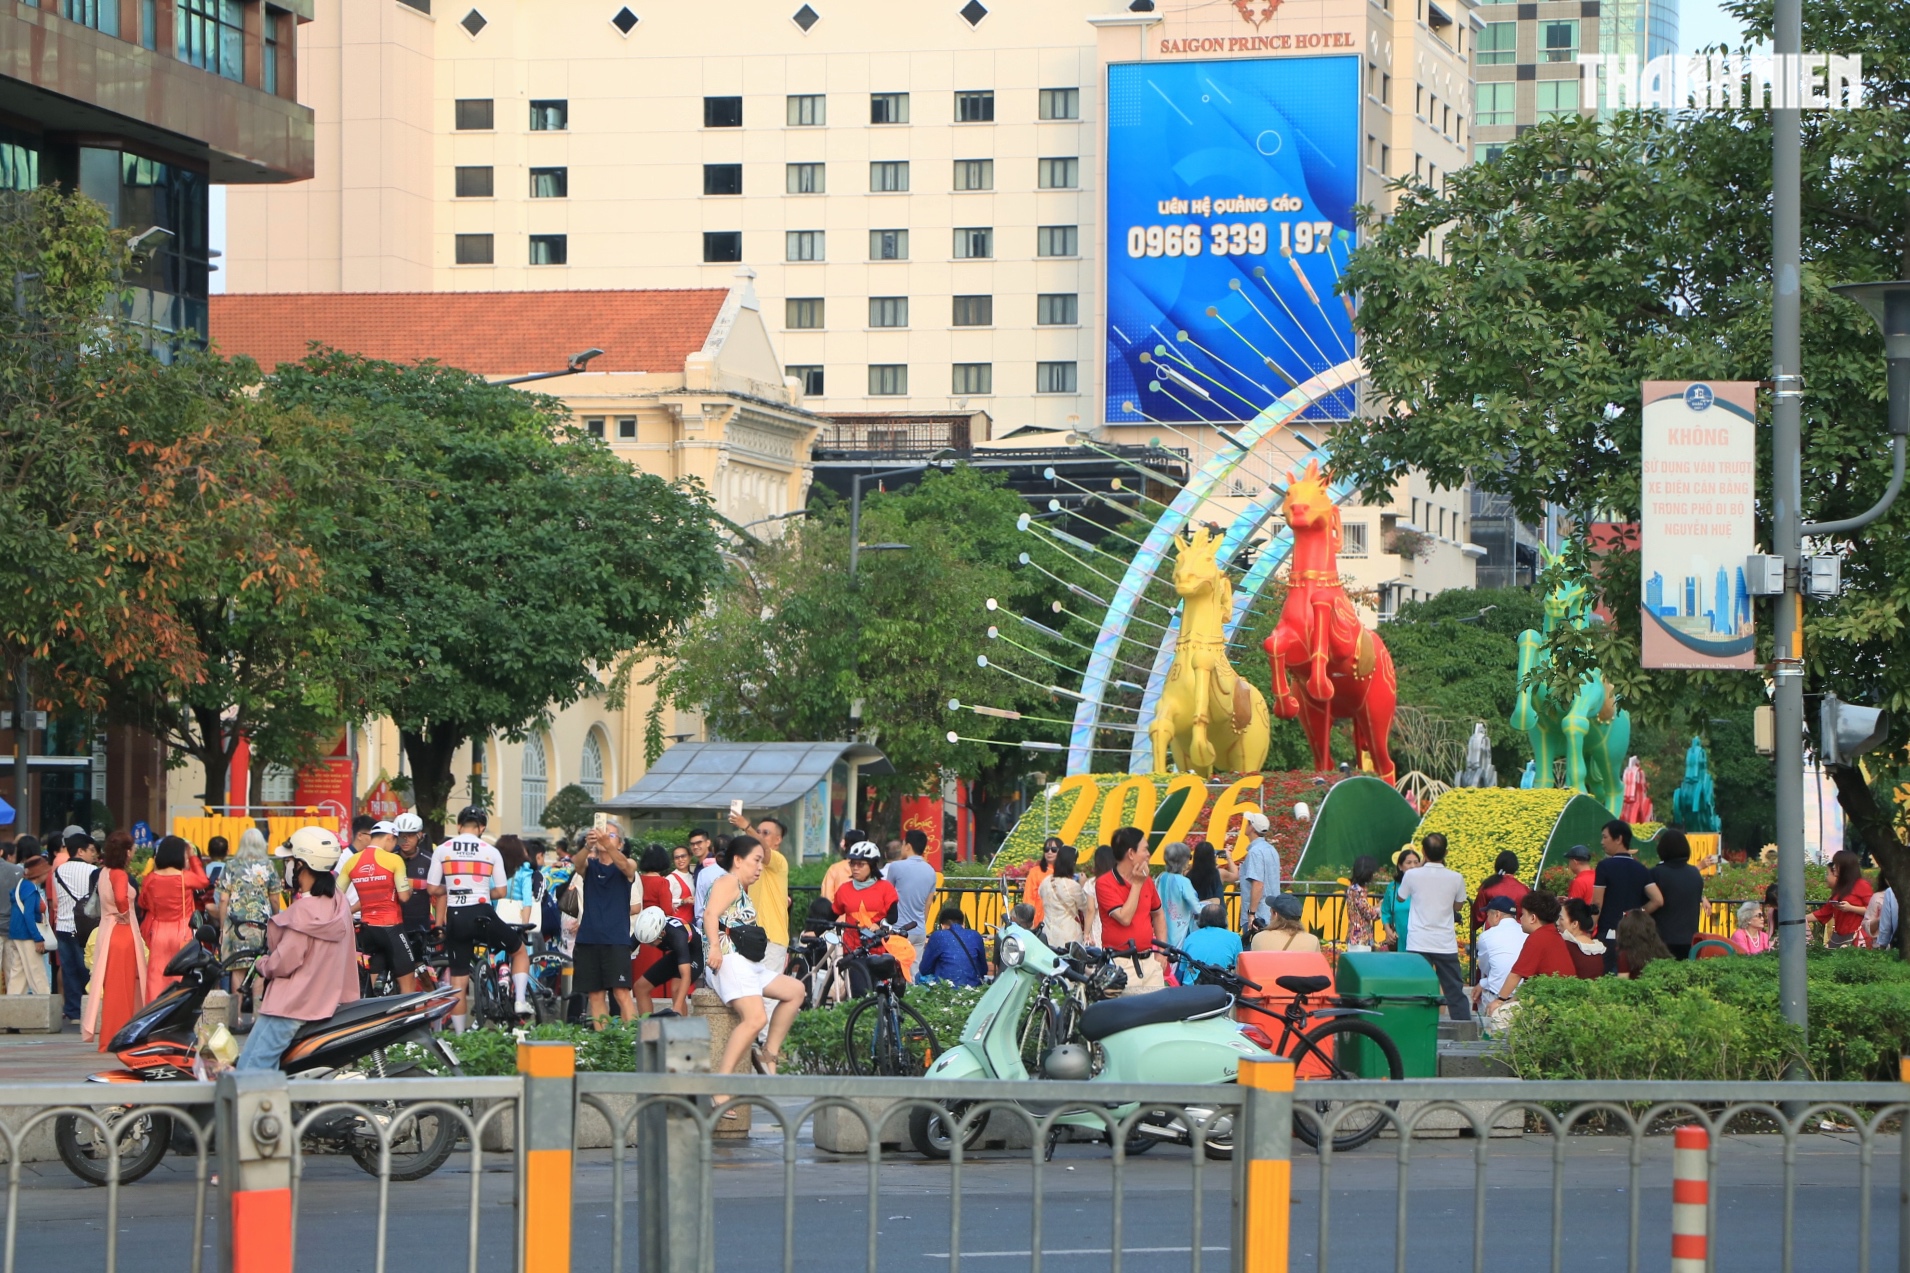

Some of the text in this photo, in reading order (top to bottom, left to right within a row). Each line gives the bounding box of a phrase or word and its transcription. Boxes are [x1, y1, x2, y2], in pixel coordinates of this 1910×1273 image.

[1160, 31, 1356, 54] SAIGON PRINCE HOTEL
[1158, 193, 1303, 218] LIÊN HỆ QUẢNG CÁO
[1127, 221, 1334, 258] 0966 339 197
[1667, 424, 1729, 446] KHÔNG
[1643, 457, 1659, 473] SỬ
[1661, 461, 1690, 476] DỤNG
[1648, 482, 1662, 495] XE
[1694, 480, 1716, 494] CÂN
[1652, 498, 1745, 517] TRONG PHỐ ĐI BỘ
[1664, 519, 1732, 538] NGUYỄN HUỆ
[1057, 774, 1265, 865] 2026
[453, 841, 480, 852] DTR
